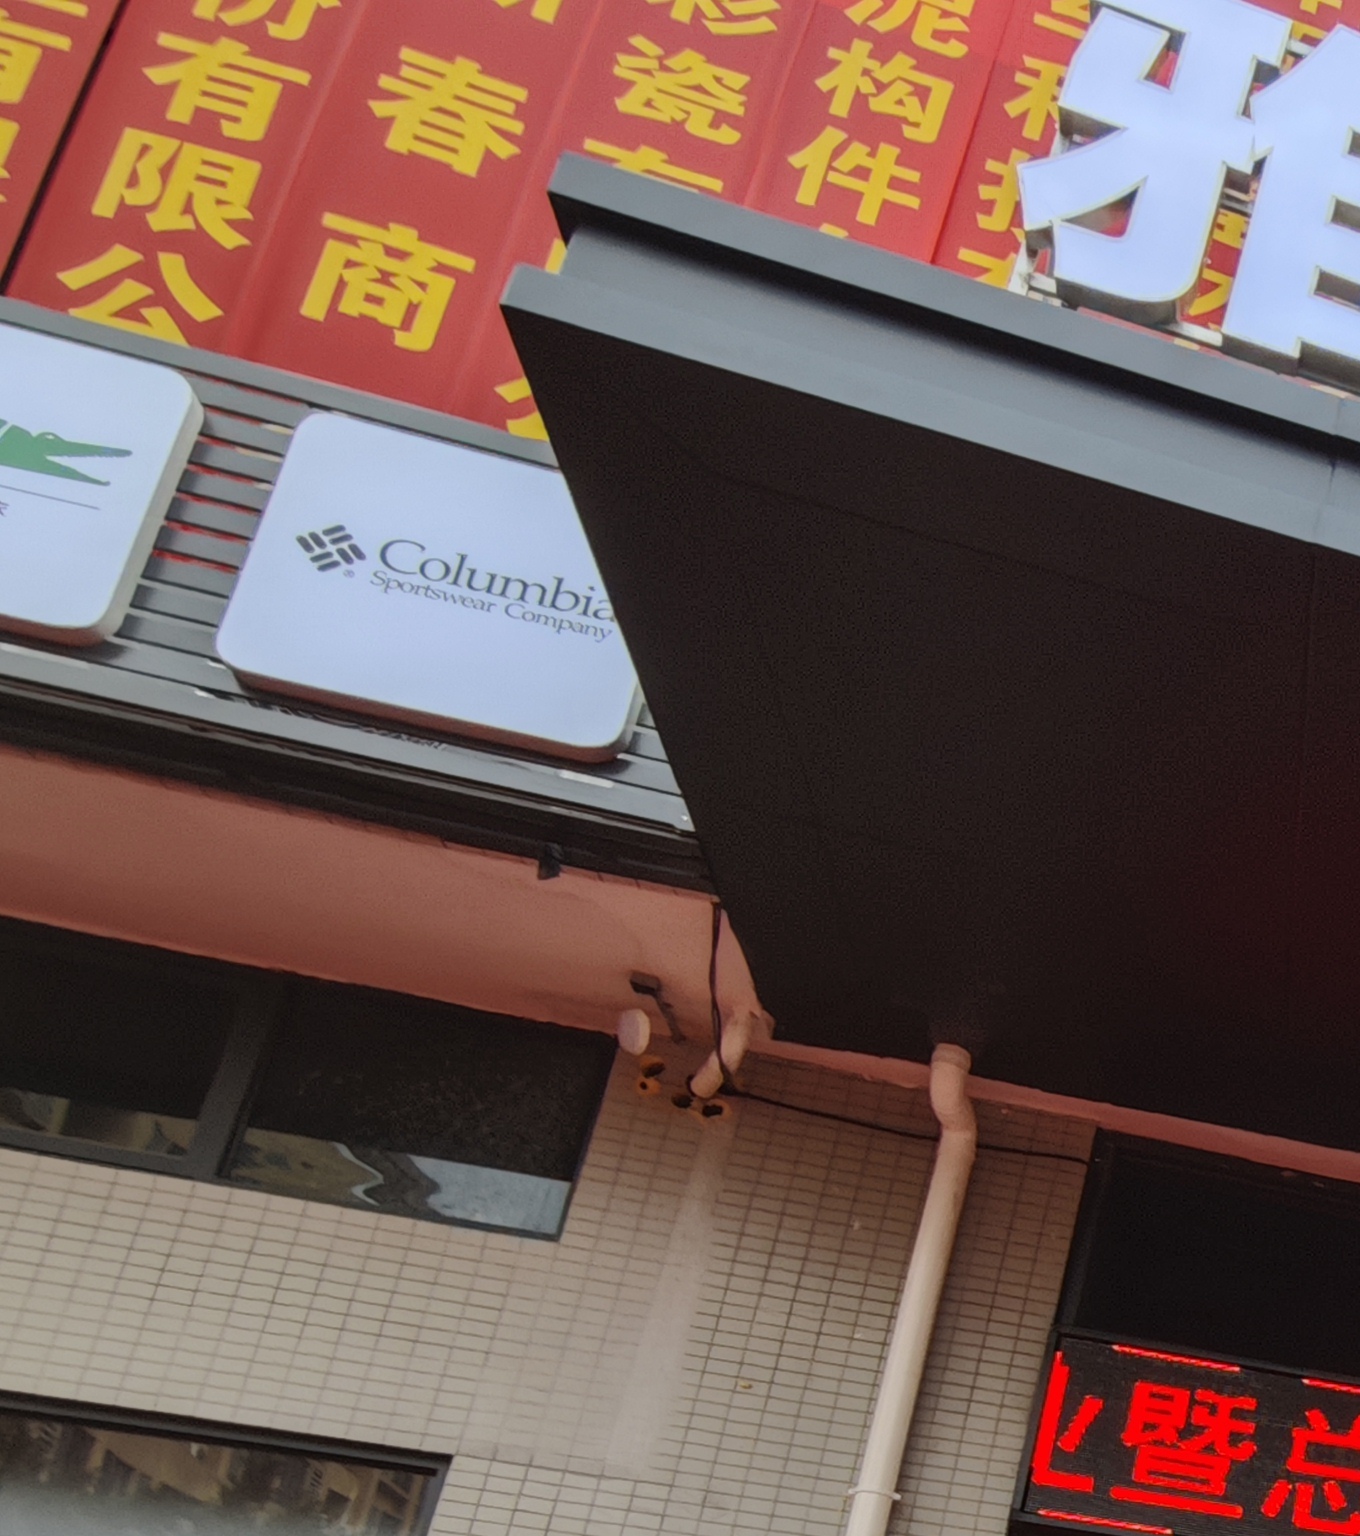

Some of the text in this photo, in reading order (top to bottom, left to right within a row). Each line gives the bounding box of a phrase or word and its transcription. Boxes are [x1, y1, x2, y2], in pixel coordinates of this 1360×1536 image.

[300, 0, 562, 352] 春商
[370, 570, 612, 643] Sportswear Company
[379, 539, 616, 622] Columbia
